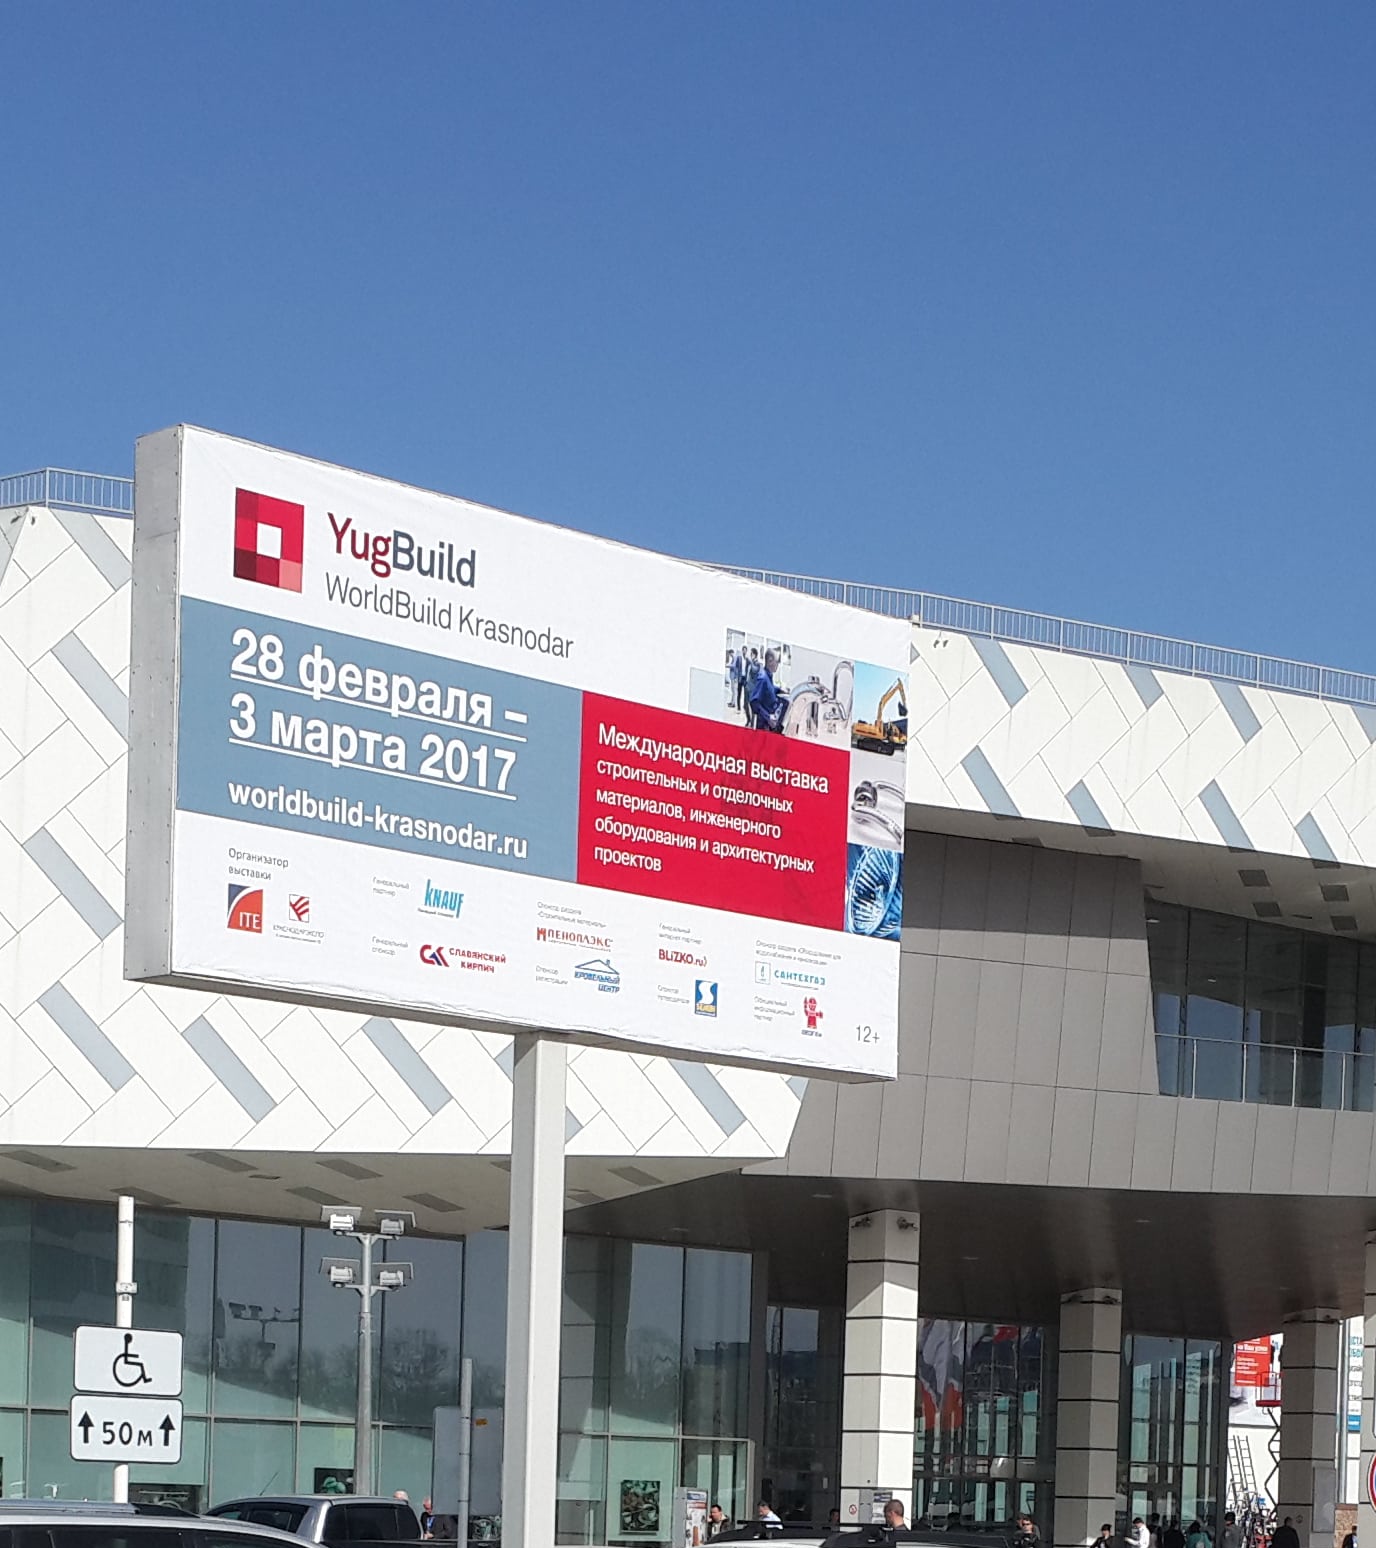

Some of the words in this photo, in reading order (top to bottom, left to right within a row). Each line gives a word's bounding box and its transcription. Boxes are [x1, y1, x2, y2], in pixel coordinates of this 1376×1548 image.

[327, 512, 476, 588] YugBuild
[325, 572, 452, 630] WorldBuild
[459, 605, 574, 659] Krasnodar
[230, 628, 285, 681] 28
[298, 645, 493, 727] февраля
[229, 692, 257, 740] 3
[271, 710, 407, 771] марта
[419, 733, 517, 792] 2017
[598, 722, 746, 776] Международная
[750, 761, 829, 794] выставка
[597, 759, 697, 793] строительных
[700, 783, 709, 796] и
[713, 785, 793, 813] отделочных
[228, 782, 528, 859] worldbuild-krasnodar.ru
[596, 789, 687, 823] материалов,
[690, 810, 781, 839] инженерного
[228, 847, 289, 870] Организатор
[595, 816, 697, 850] оборудования
[700, 839, 709, 852] и
[712, 841, 815, 873] архитектурных
[595, 846, 662, 872] проектов
[228, 865, 272, 880] выставки
[239, 911, 261, 930] ITE
[424, 878, 464, 918] KNAUF
[449, 947, 507, 964] СЛАВЯНСКИЙ
[460, 960, 495, 973] КИРПИЧ
[774, 970, 826, 985] САНТЕХГАЗ
[855, 1024, 880, 1044] 12+
